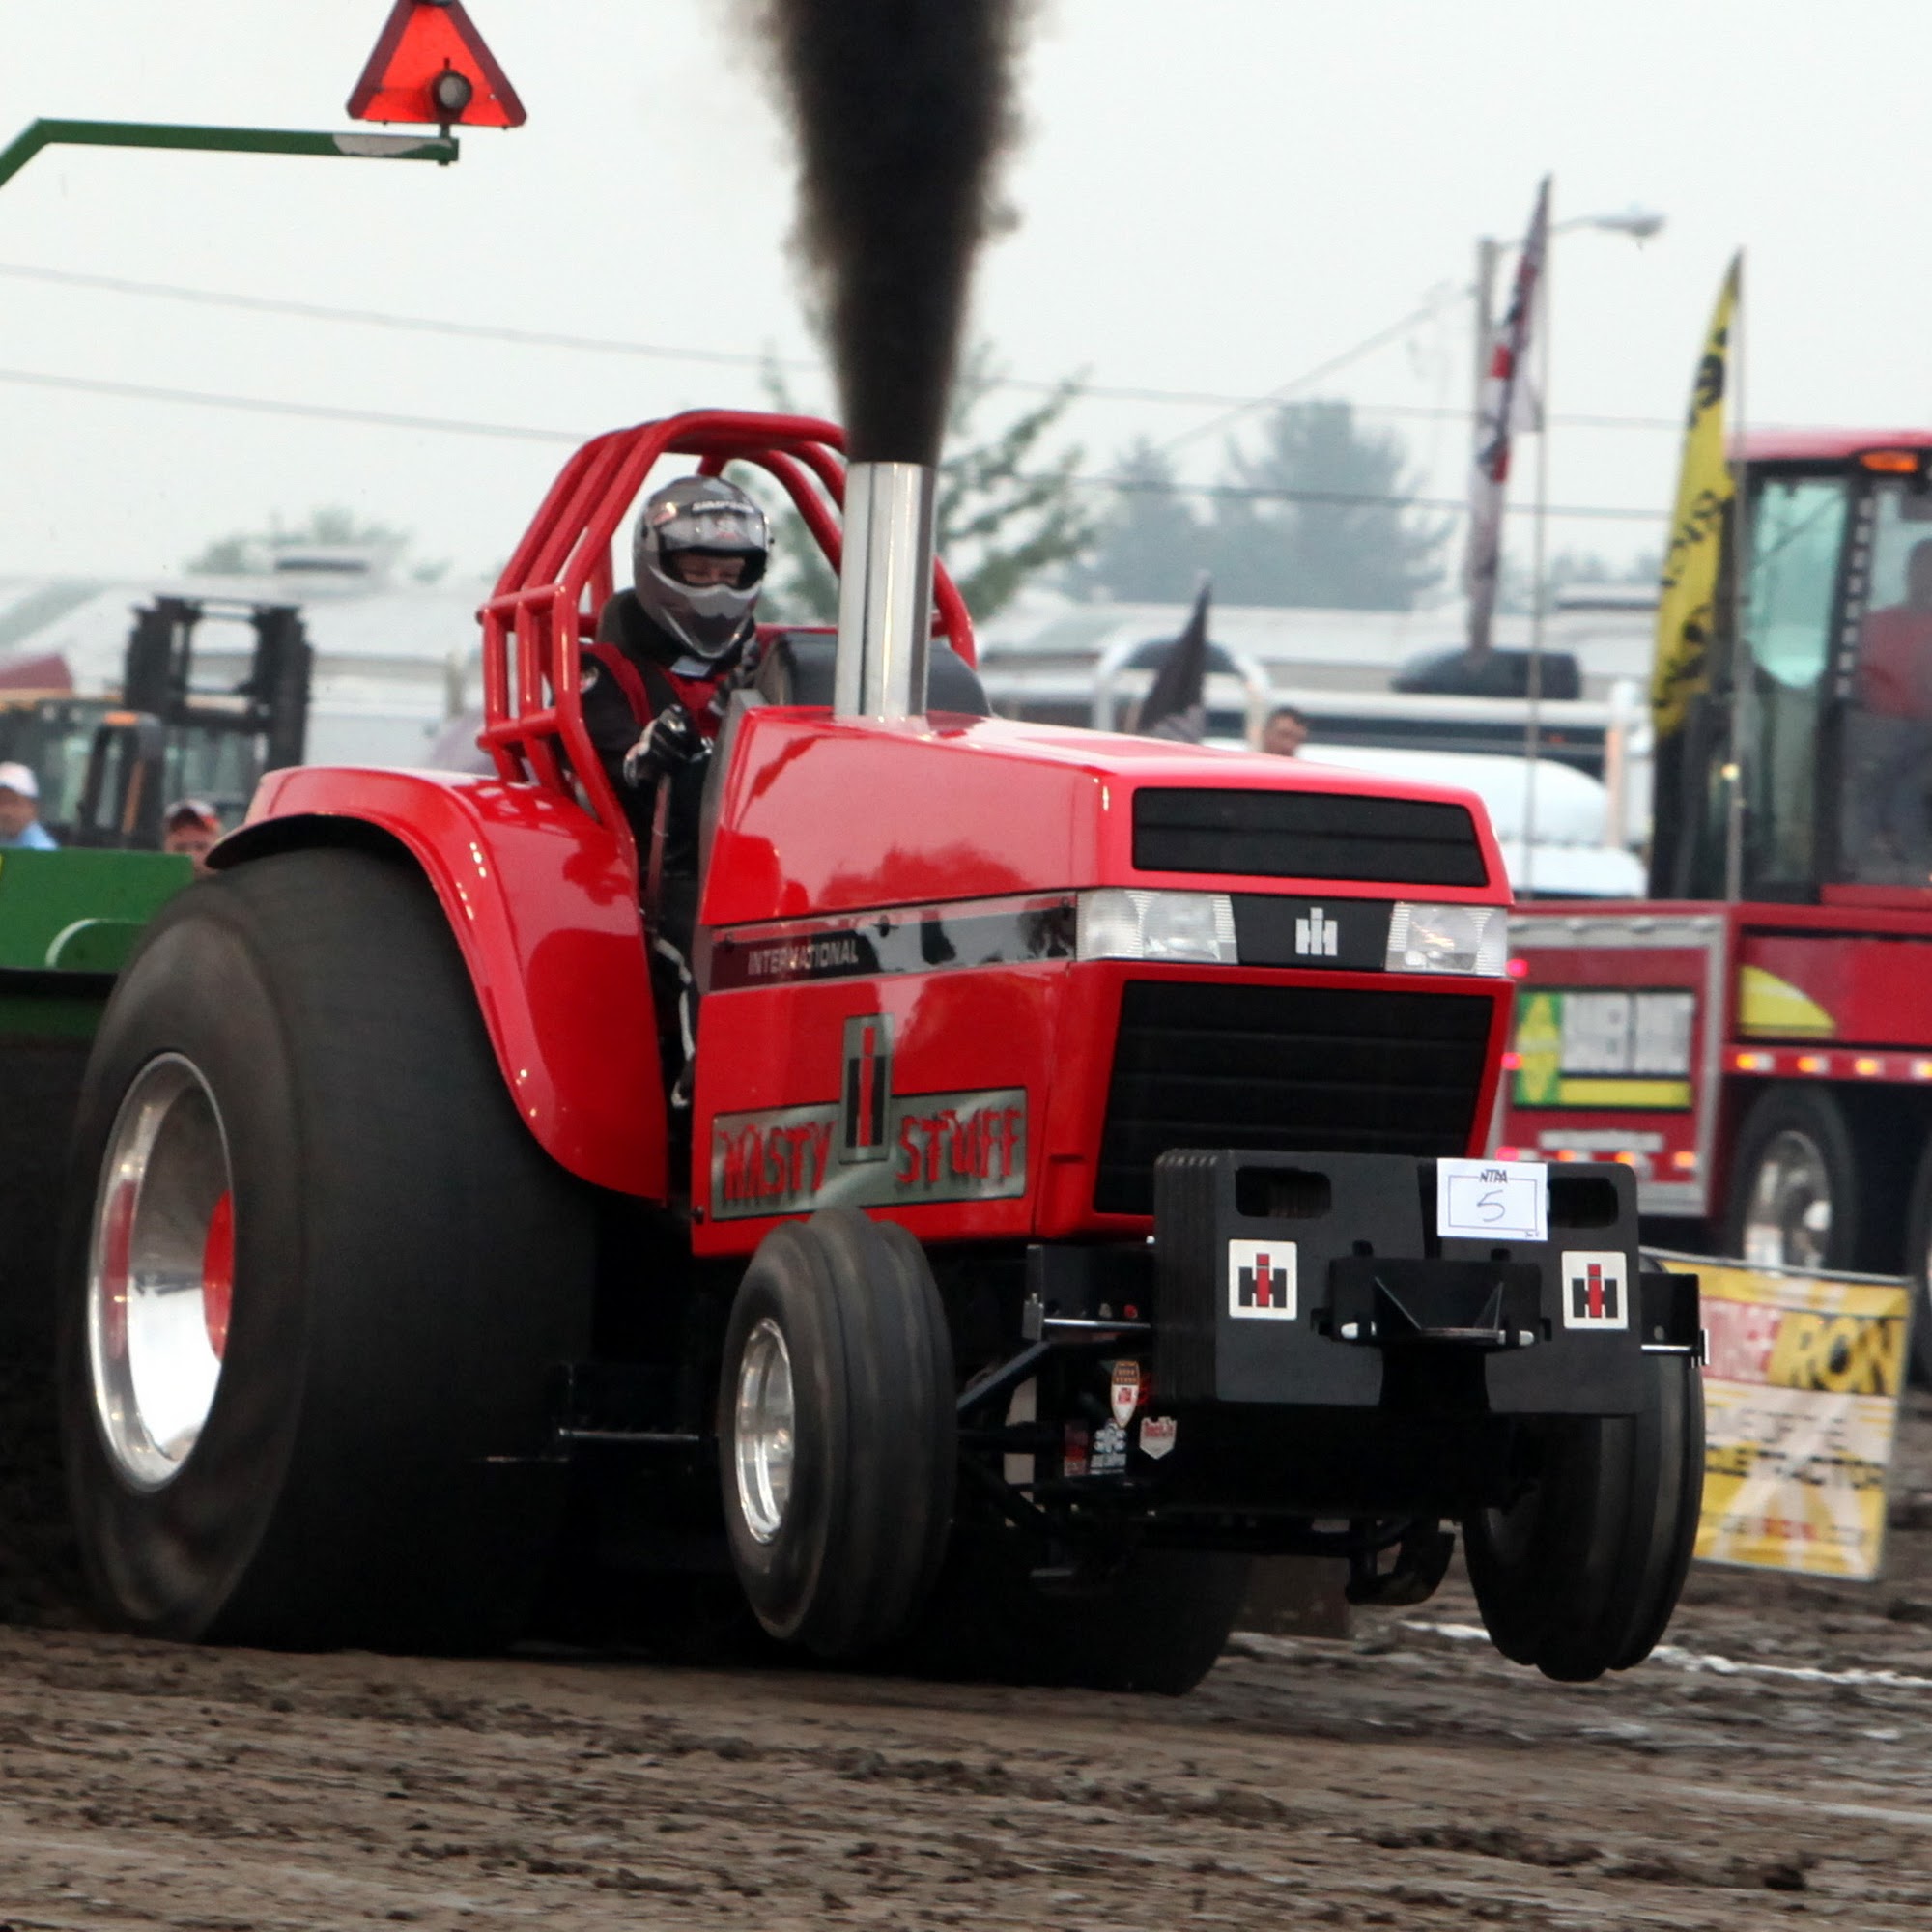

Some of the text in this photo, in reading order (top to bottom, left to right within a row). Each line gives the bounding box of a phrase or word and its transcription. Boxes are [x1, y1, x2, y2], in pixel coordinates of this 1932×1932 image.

[718, 1108, 1022, 1200] NASTY STUFF
[1479, 1168, 1509, 1183] NTPA
[1476, 1188, 1506, 1223] 5
